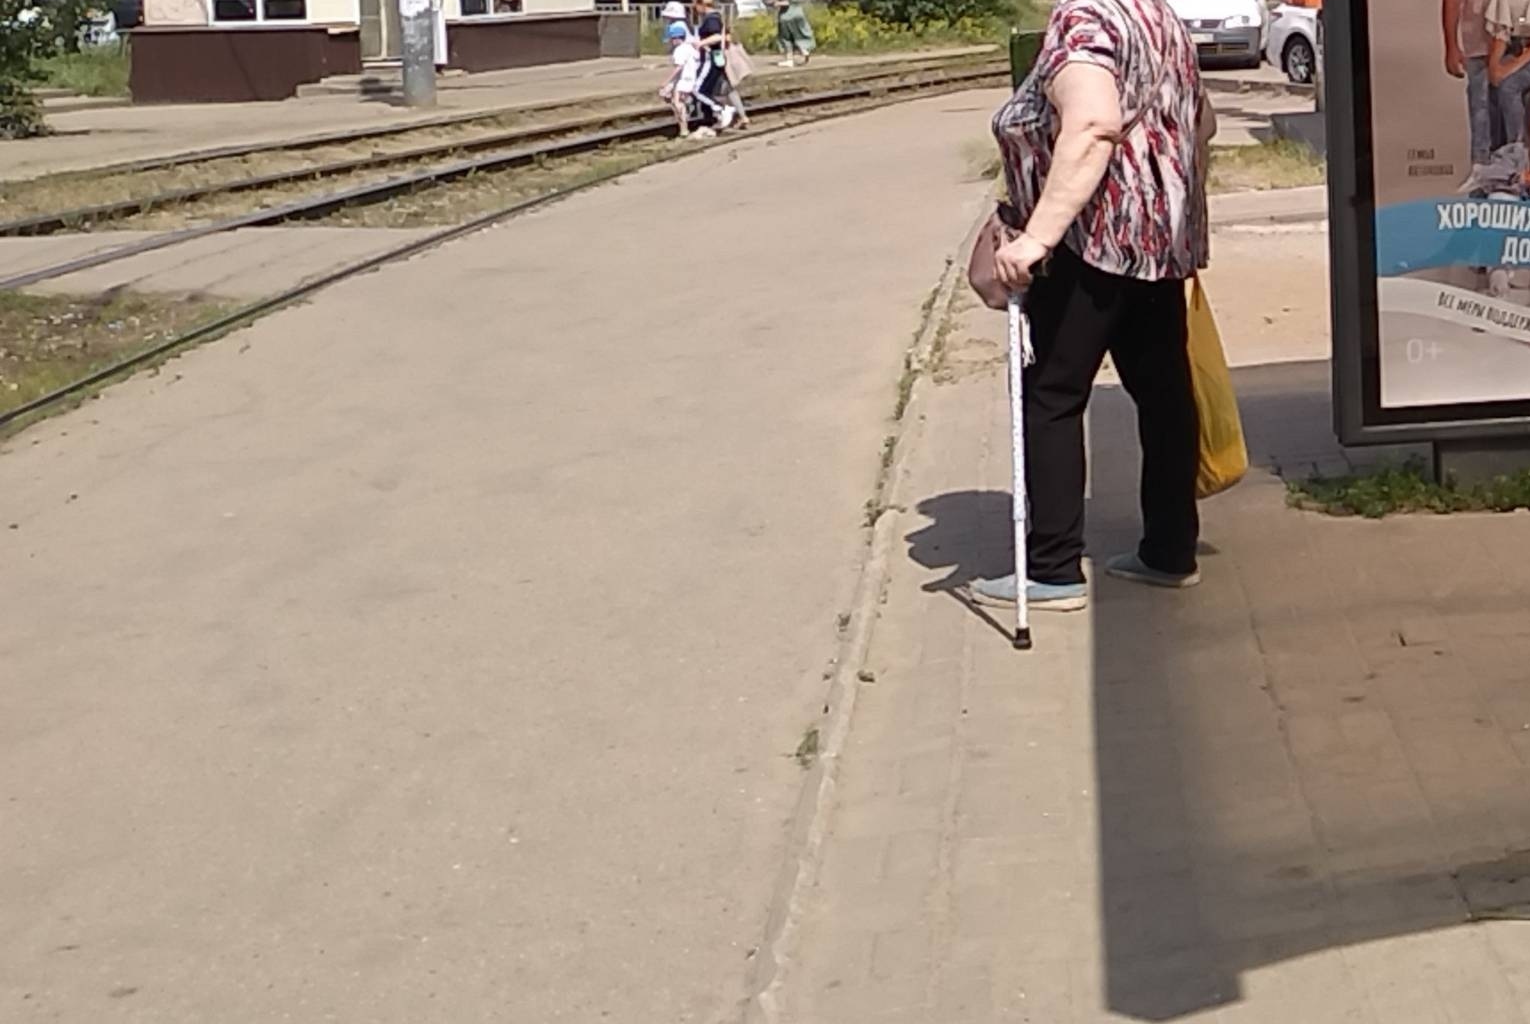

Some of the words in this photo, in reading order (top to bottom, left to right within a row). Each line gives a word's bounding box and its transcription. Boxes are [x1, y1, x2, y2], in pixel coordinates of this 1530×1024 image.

[1437, 291, 1454, 308] ВСЕ
[1457, 297, 1484, 318] МЕРЫ
[1406, 338, 1444, 364] 0+
